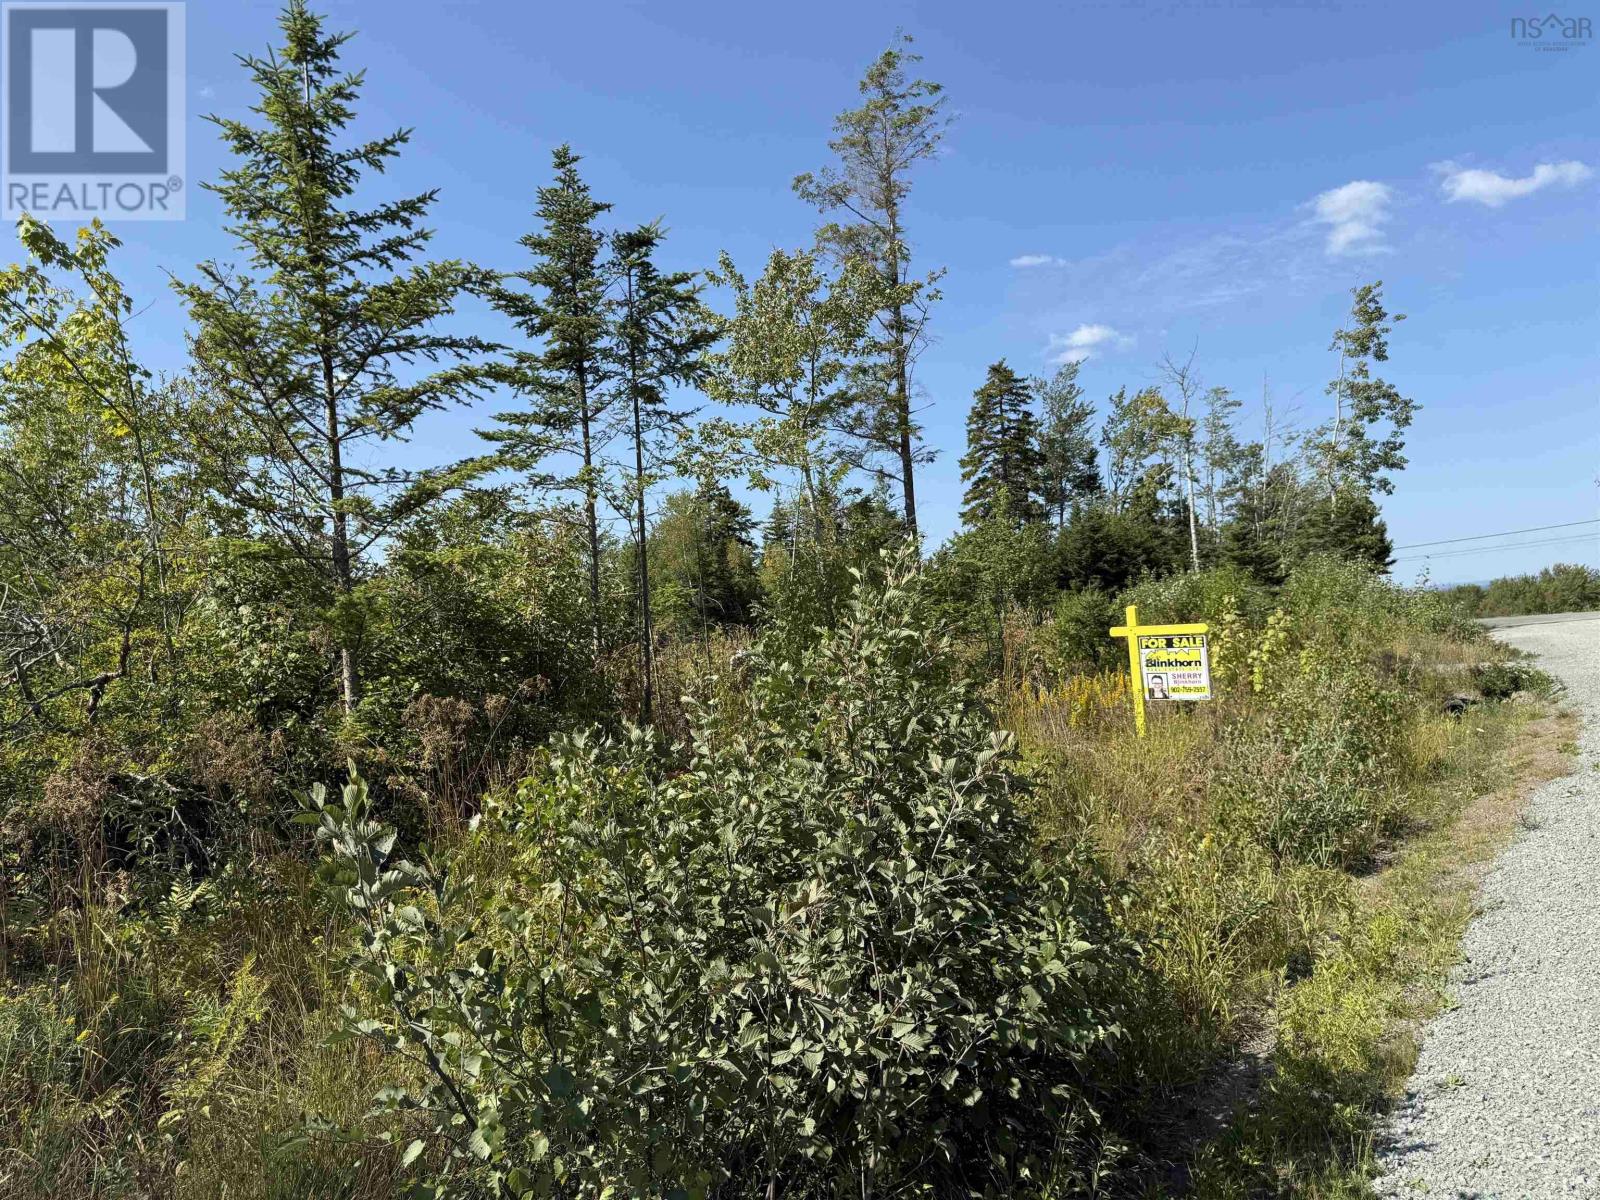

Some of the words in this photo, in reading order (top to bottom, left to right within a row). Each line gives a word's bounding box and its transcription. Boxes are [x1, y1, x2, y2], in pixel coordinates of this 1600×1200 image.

[1141, 638, 1166, 648] FOR
[1172, 637, 1202, 647] SALE
[1146, 659, 1201, 667] Blinkhorn
